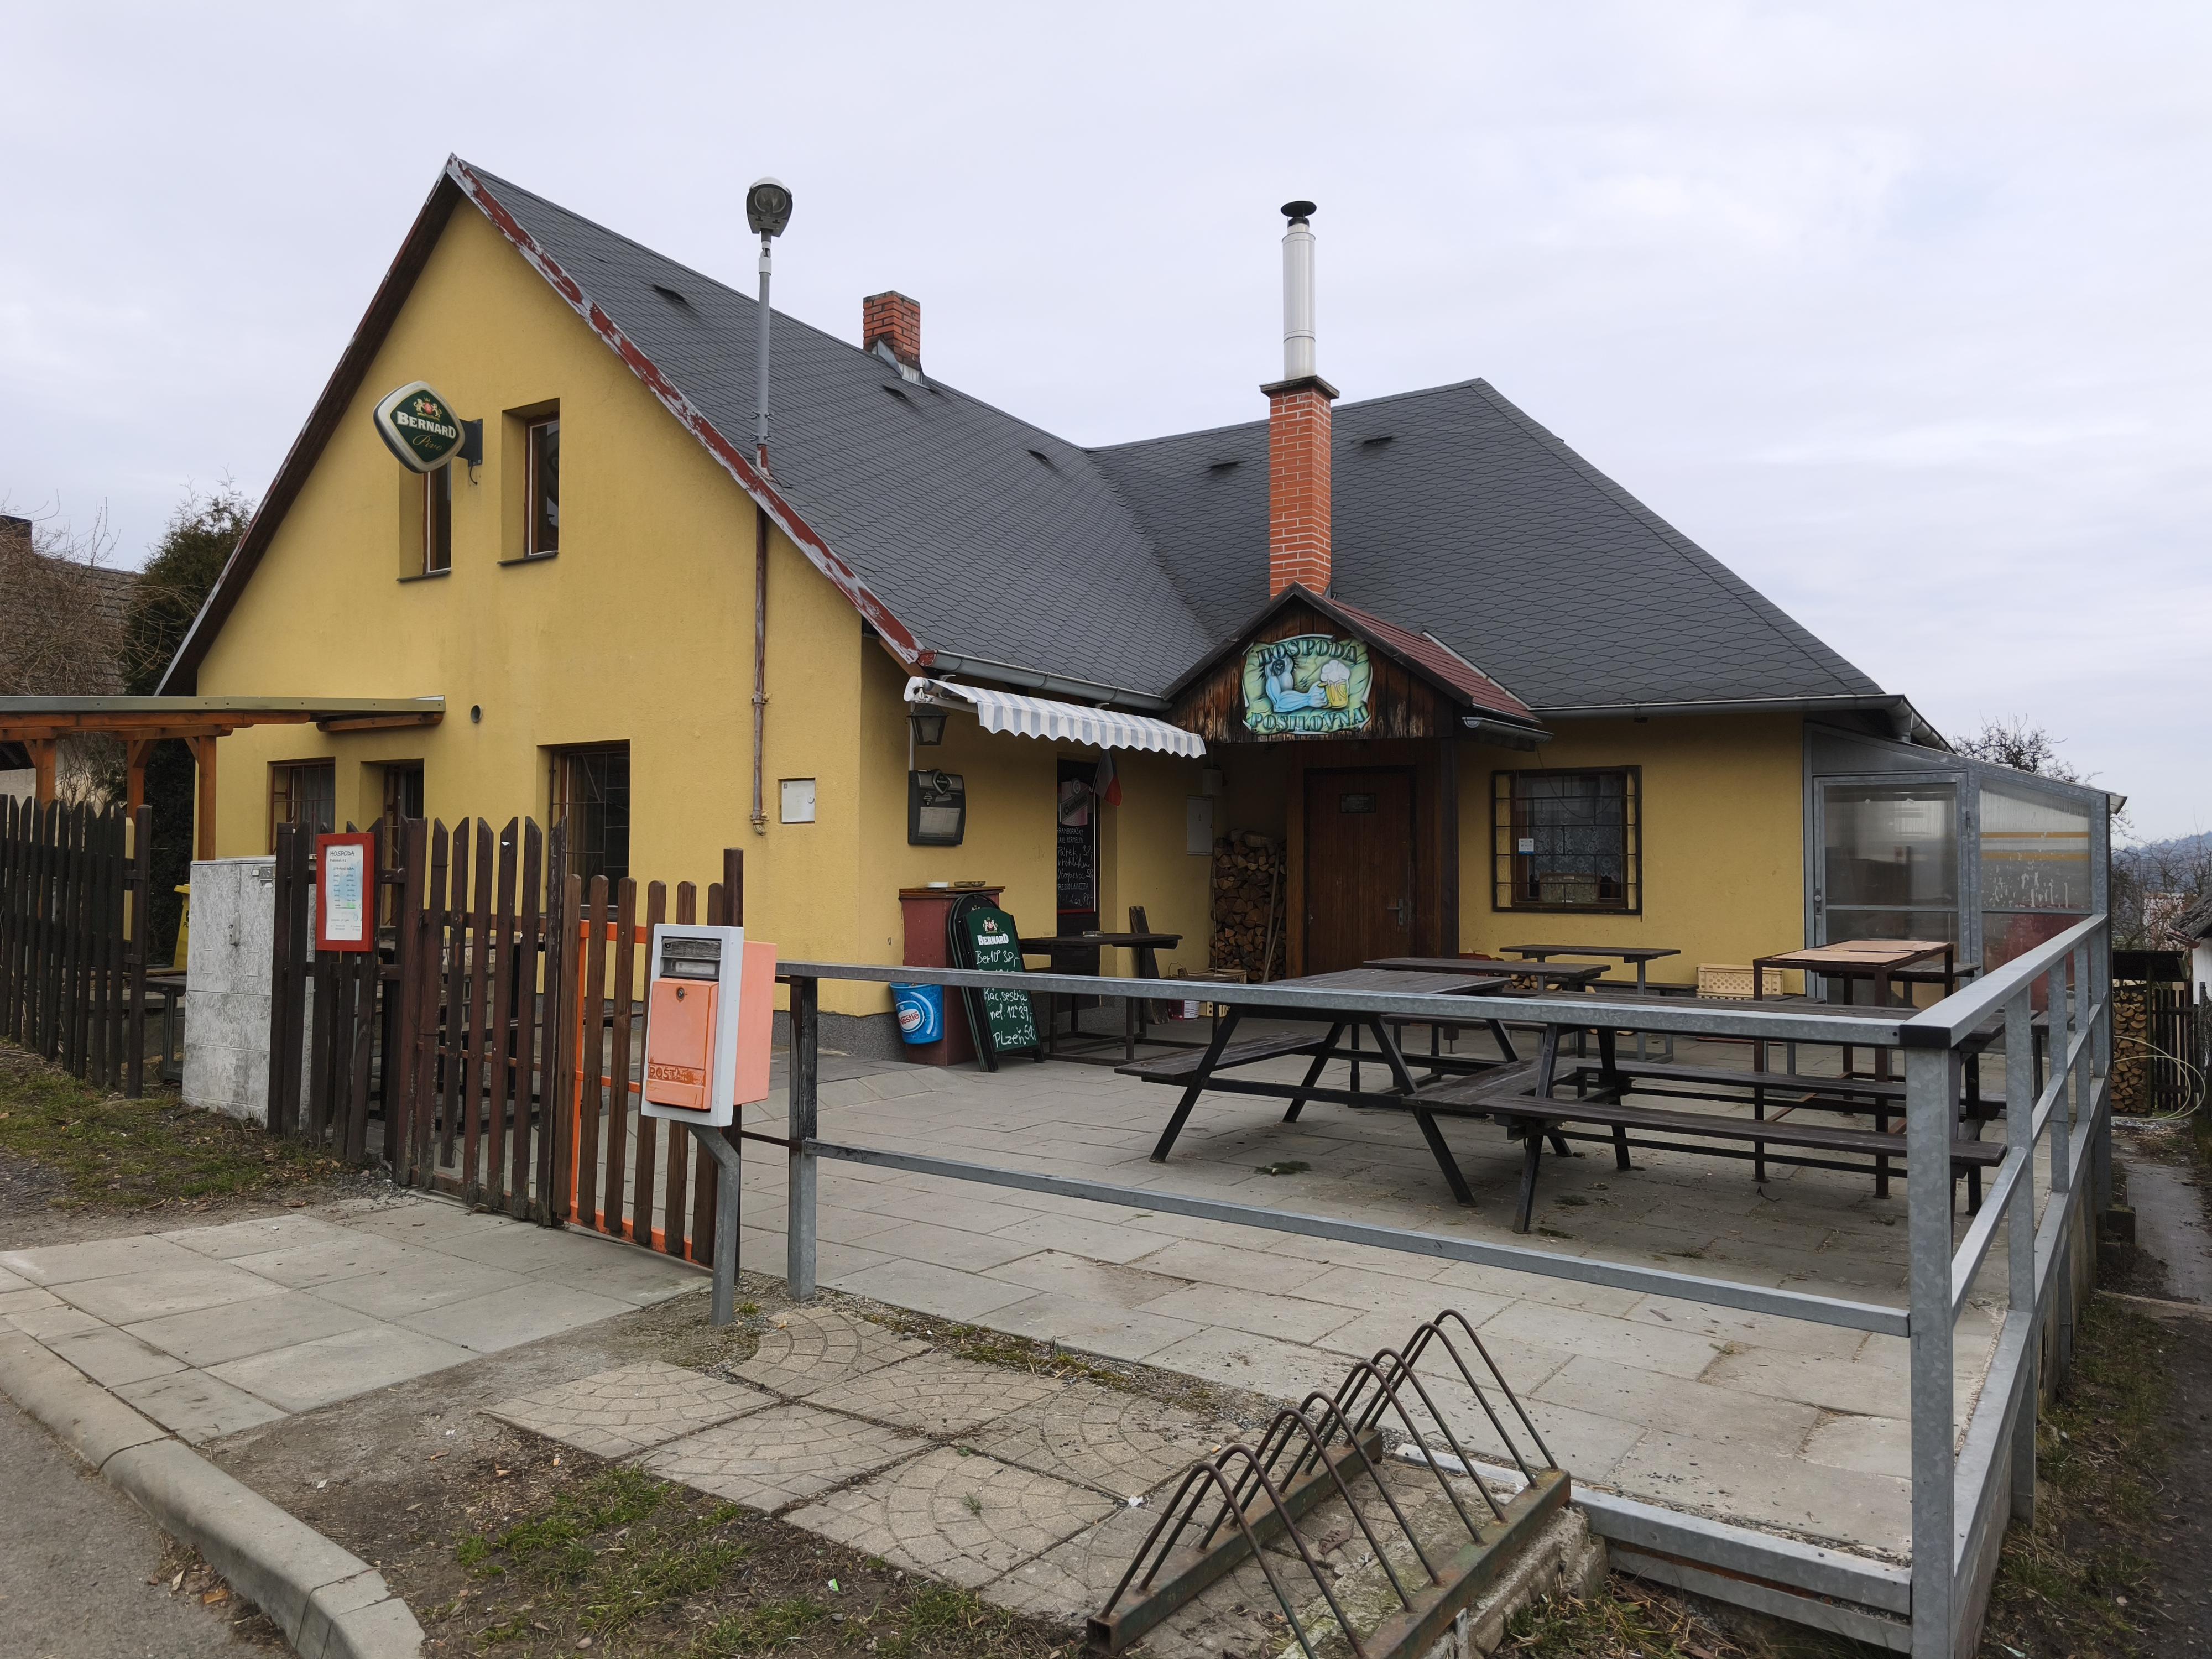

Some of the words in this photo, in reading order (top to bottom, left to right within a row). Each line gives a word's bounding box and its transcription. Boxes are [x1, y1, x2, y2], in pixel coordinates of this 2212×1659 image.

[396, 411, 456, 439] BERNARD
[413, 434, 442, 451] Pivo
[1256, 639, 1358, 666] HOSPODA
[1250, 705, 1368, 731] POSILOVNA
[977, 933, 1009, 946] BERNARD
[899, 1011, 920, 1025] Nestlé
